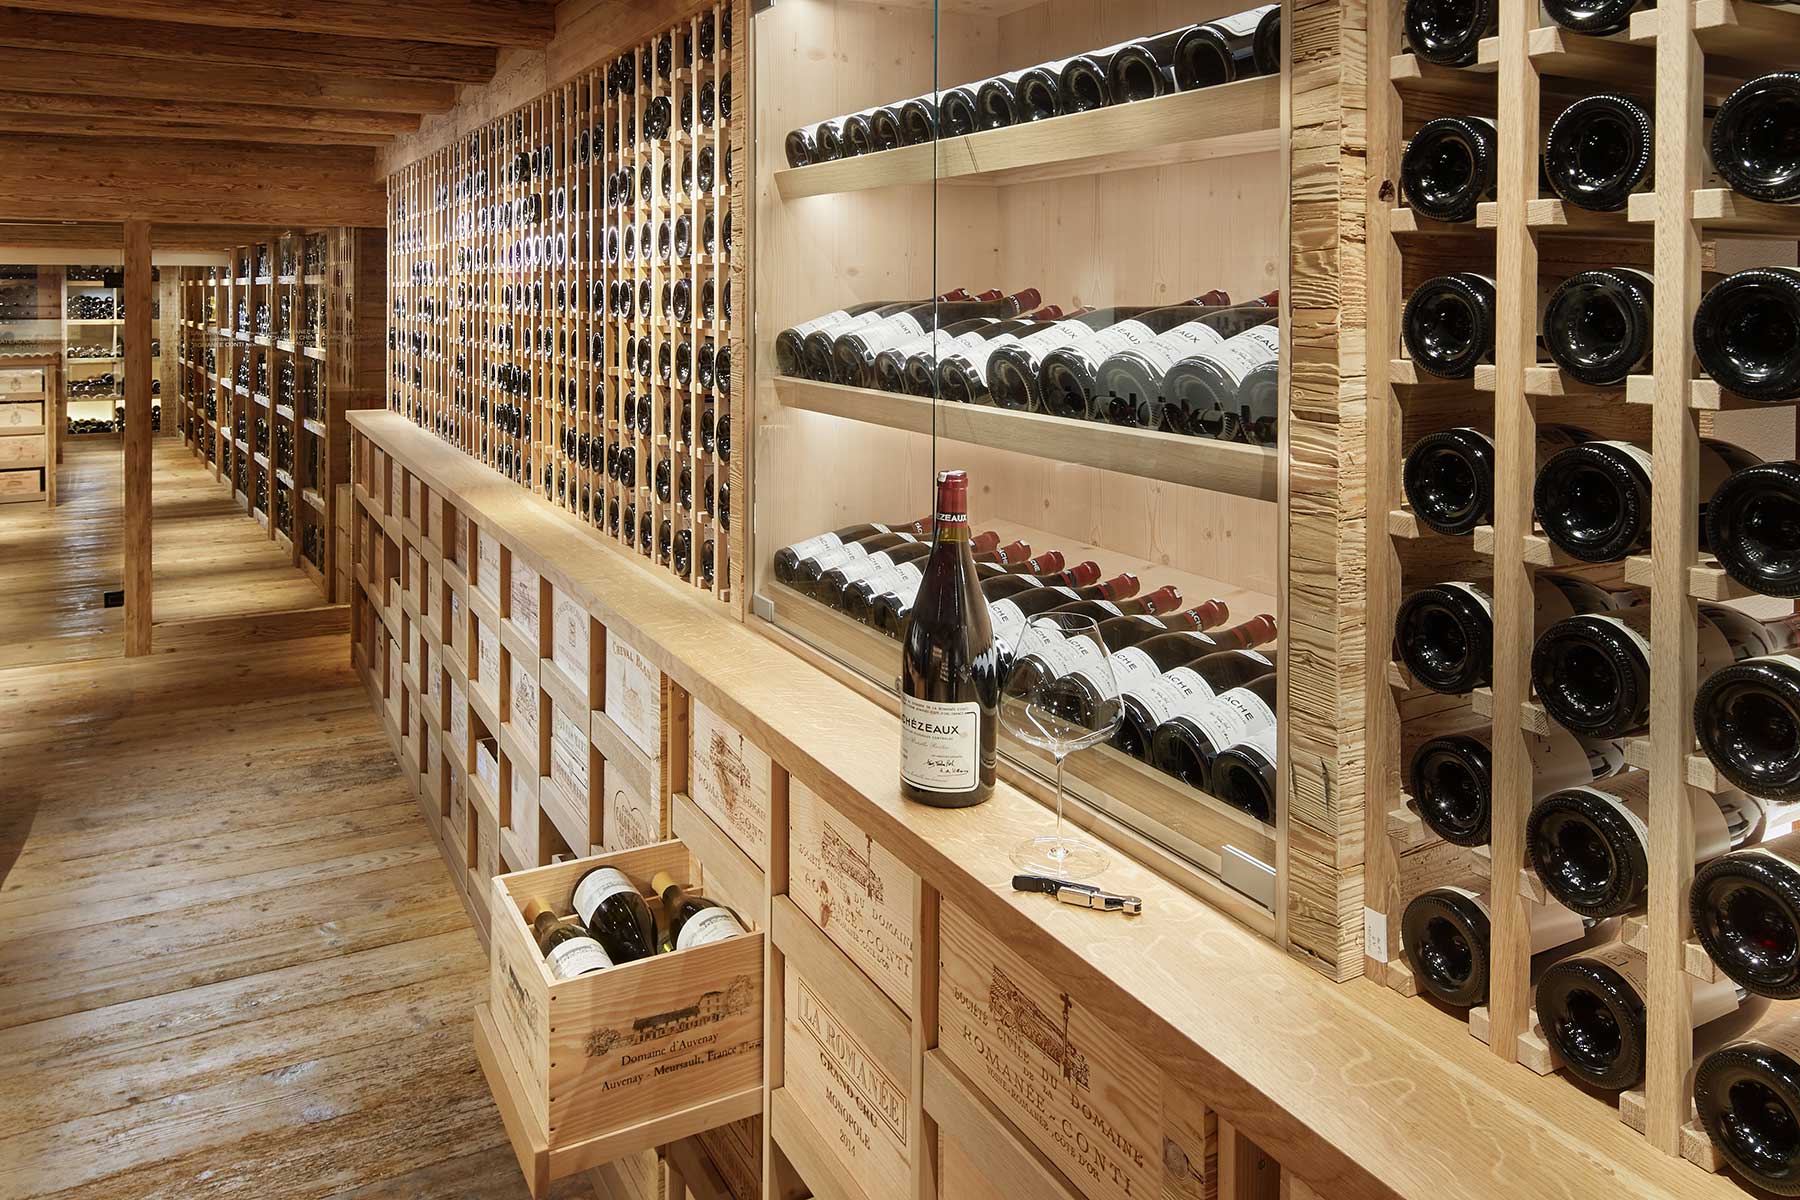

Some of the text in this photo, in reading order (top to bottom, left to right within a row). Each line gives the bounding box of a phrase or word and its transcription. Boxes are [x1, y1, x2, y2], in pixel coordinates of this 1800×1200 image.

[804, 998, 821, 1036] LA
[601, 1073, 645, 1092] Auvenay
[707, 1046, 737, 1062] France
[621, 1048, 667, 1067] Domaine
[669, 1033, 719, 1056] d'Auvenay
[1023, 1066, 1035, 1081] DE
[819, 1051, 854, 1099] GRAND
[996, 1026, 1030, 1065] CIVILE
[1041, 1066, 1058, 1090] DU
[1070, 1091, 1144, 1169] DOMAINE
[825, 1086, 871, 1151] MONOPOLE
[1061, 1118, 1132, 1198] CONTI
